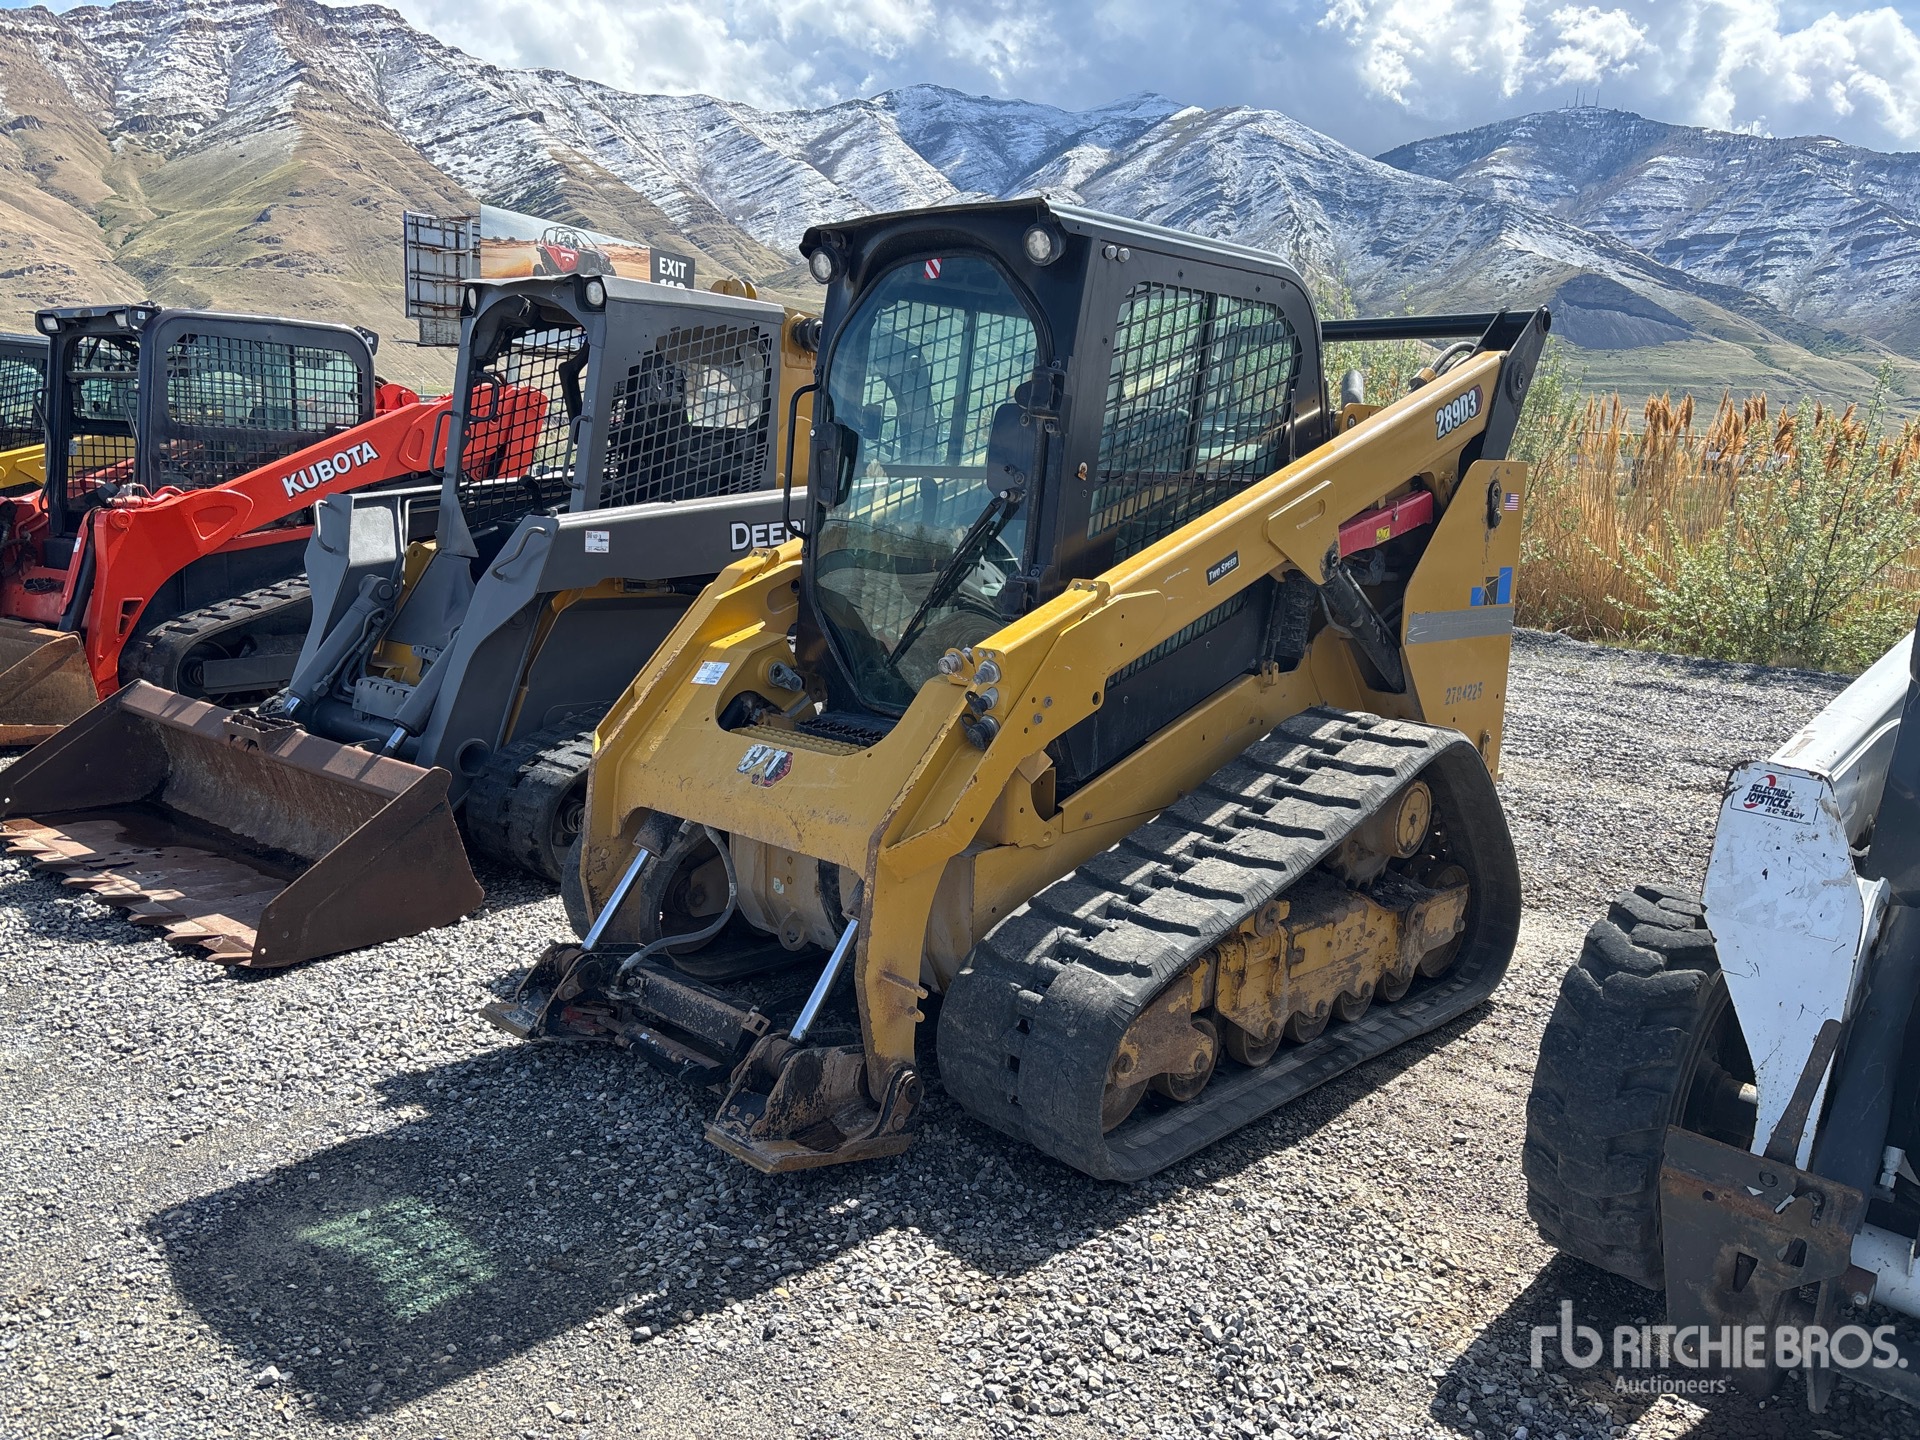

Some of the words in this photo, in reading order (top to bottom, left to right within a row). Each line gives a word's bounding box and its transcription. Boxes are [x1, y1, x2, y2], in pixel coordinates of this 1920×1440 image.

[659, 256, 687, 279] EXIT
[1436, 389, 1477, 439] 289D3
[281, 440, 379, 498] KUBOTA
[731, 519, 806, 550] DEER
[1744, 791, 1791, 809] JOYSTICKS
